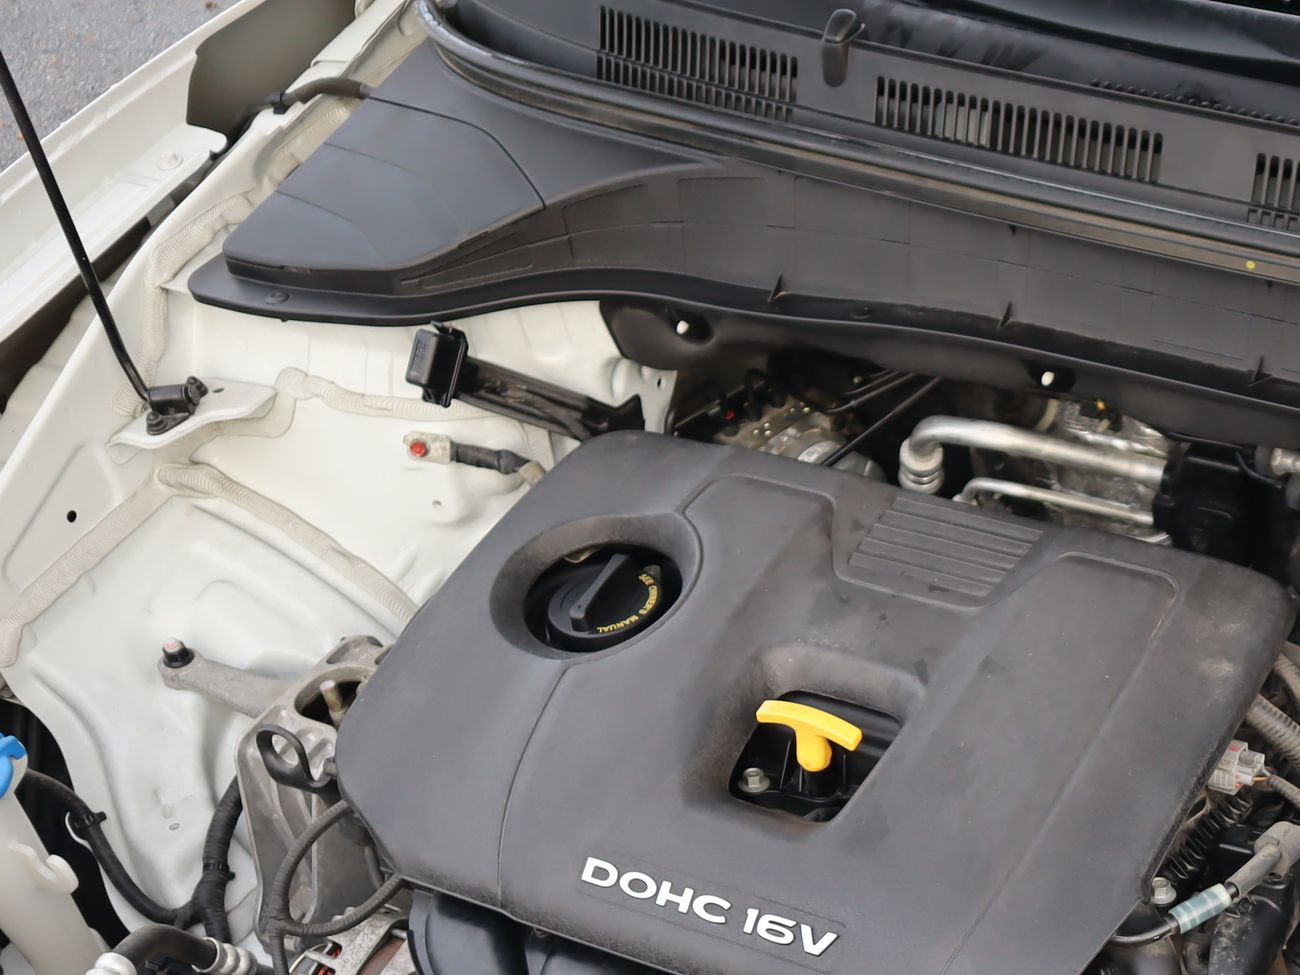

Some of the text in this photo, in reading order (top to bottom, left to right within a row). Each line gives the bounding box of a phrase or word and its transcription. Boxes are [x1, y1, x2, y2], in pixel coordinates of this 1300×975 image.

[639, 573, 655, 585] SEE
[596, 614, 639, 633] MANUAL
[581, 856, 839, 957] DOHC 16V
